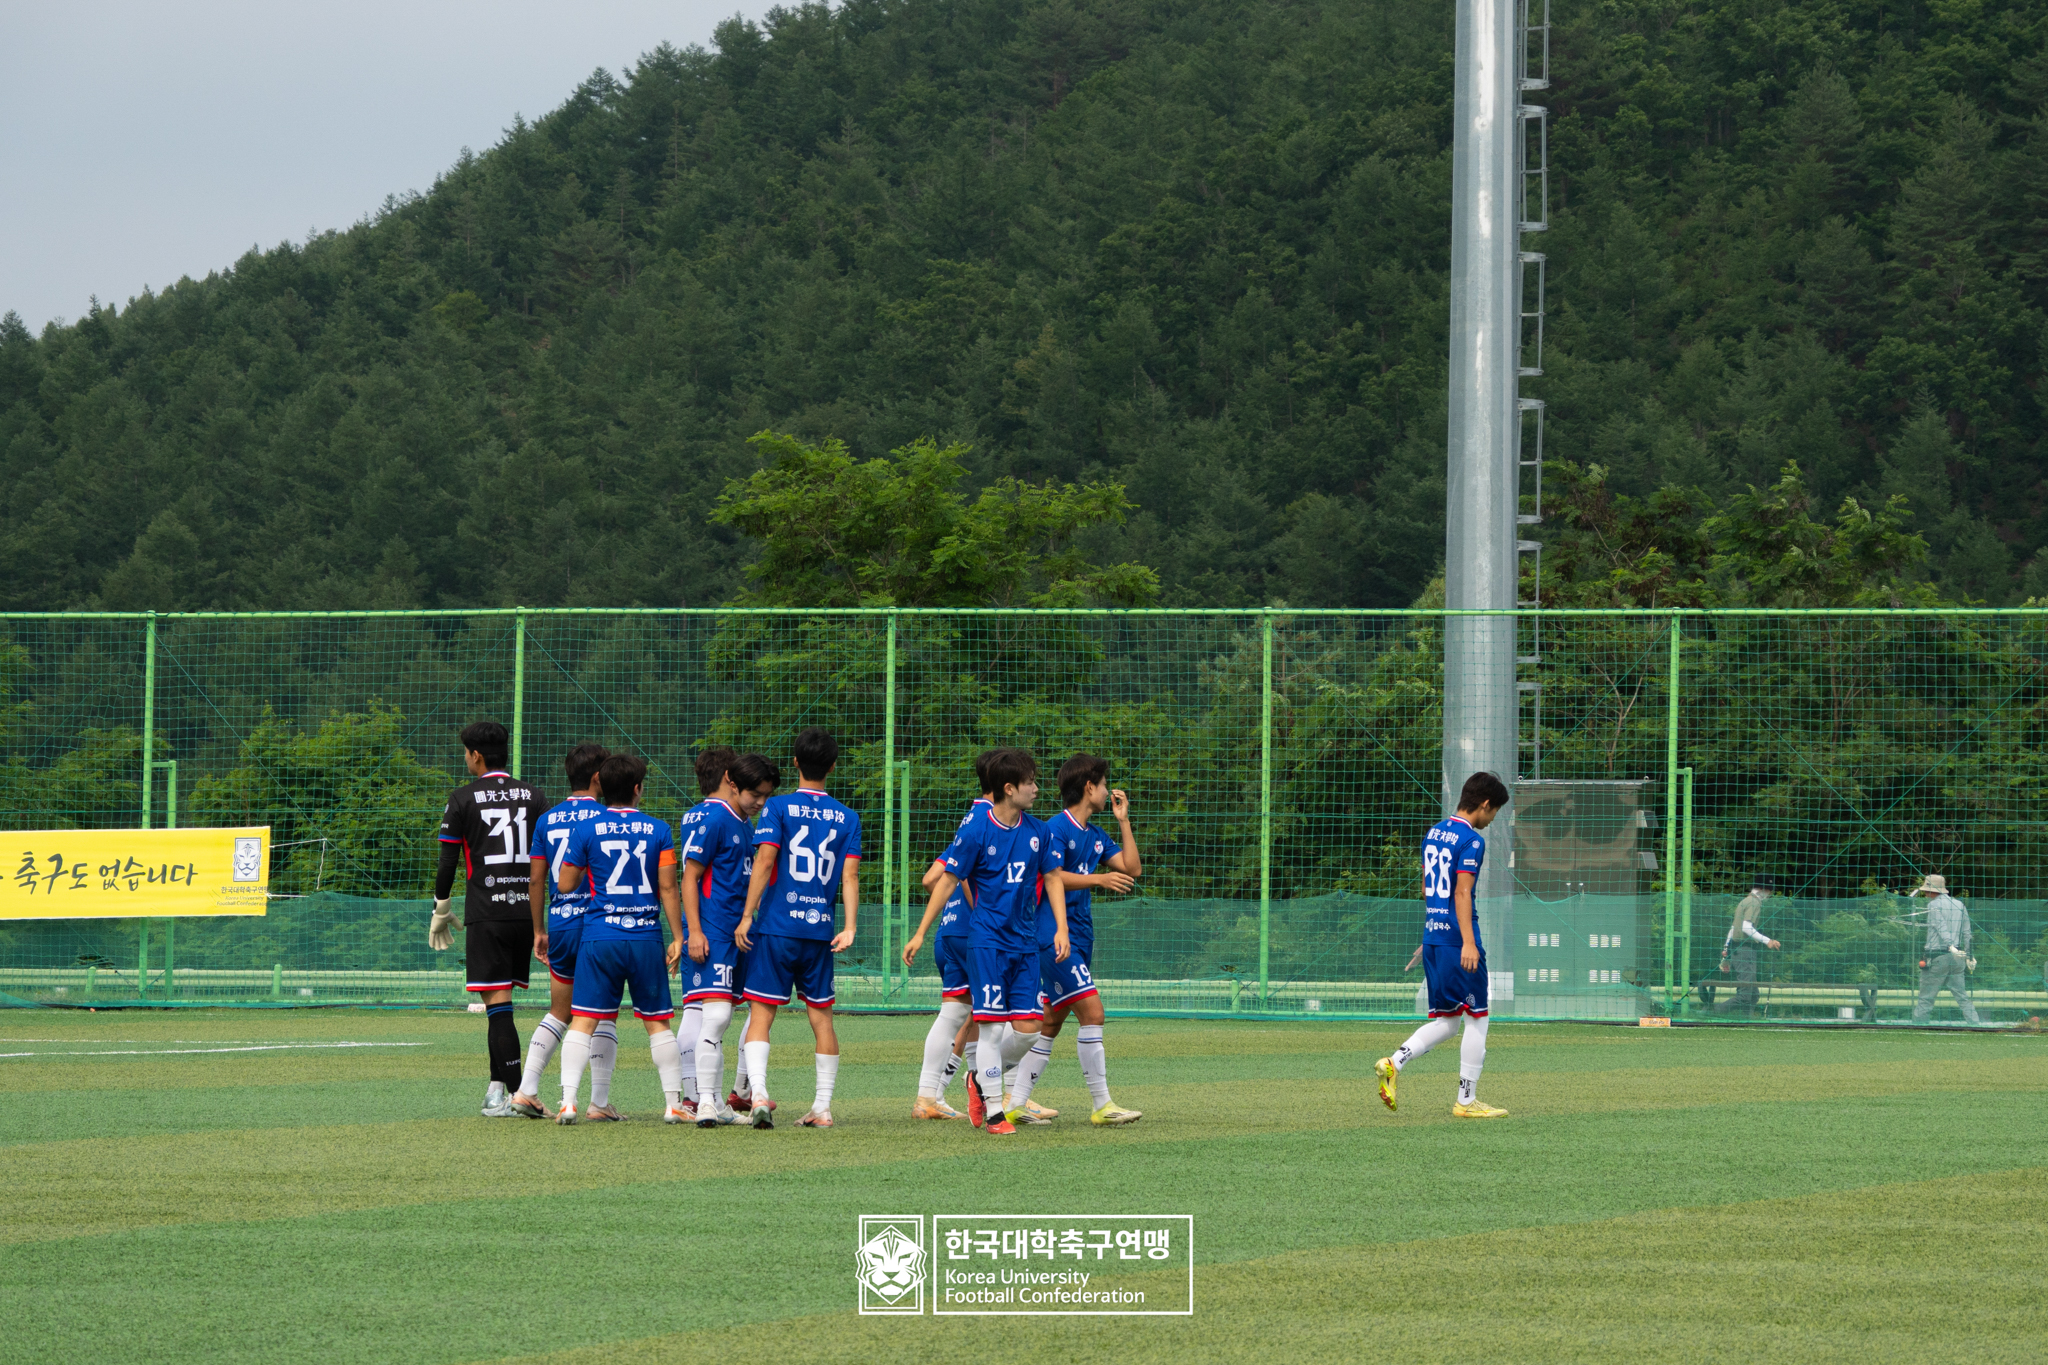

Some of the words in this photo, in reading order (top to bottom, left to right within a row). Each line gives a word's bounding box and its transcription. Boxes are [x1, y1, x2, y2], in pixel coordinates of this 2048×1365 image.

[481, 807, 530, 864] 31
[547, 829, 569, 883] 7
[789, 825, 837, 885] 66
[14, 851, 88, 895] 축구도
[98, 856, 199, 892] 없습니다
[601, 840, 652, 894] 21
[713, 964, 732, 987] 30
[983, 984, 1003, 1008] 12
[1071, 964, 1092, 987] 19
